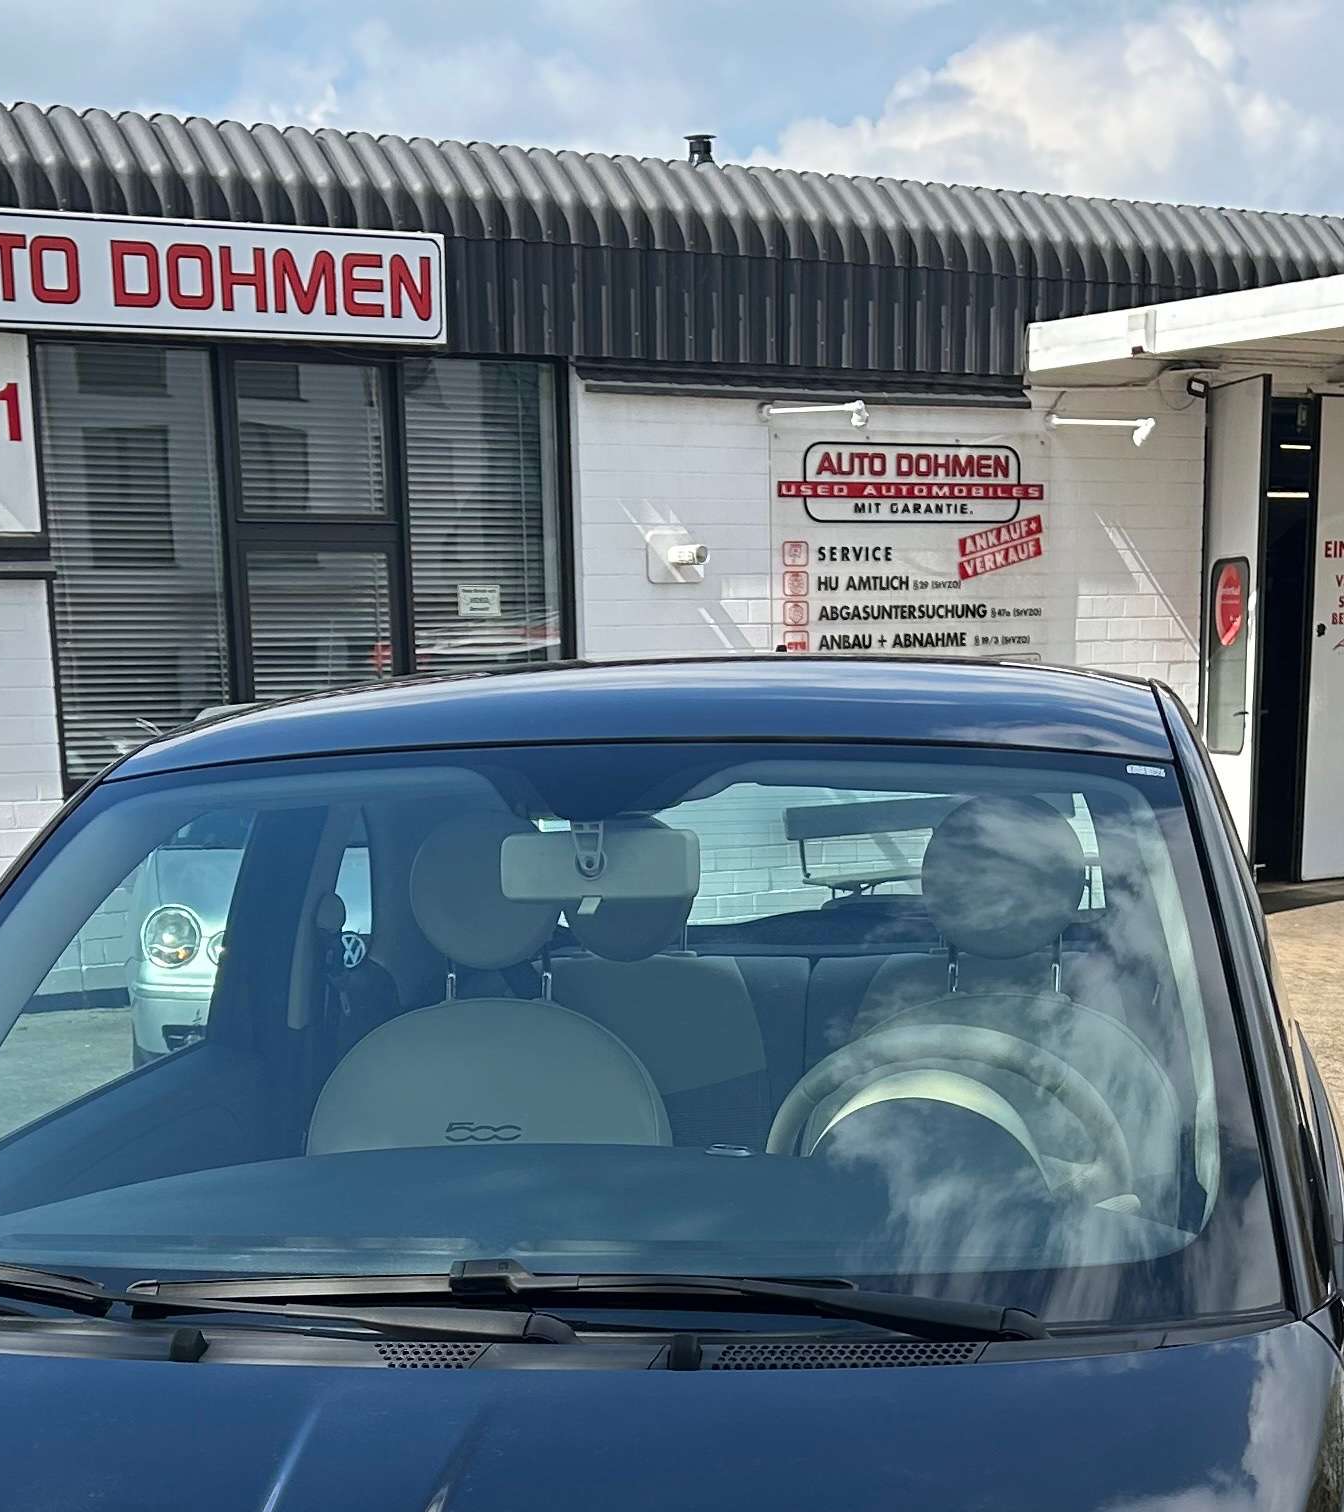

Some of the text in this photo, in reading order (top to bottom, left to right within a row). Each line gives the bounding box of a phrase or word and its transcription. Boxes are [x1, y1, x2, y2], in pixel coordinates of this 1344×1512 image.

[111, 239, 432, 322] DOHMEN
[816, 451, 1010, 478] AUTO DOHMEN
[780, 484, 1041, 498] USED AUTOMOBILES
[854, 502, 881, 514] MIT
[818, 546, 893, 562] SERVICE
[963, 543, 1038, 578] VERKAUF
[818, 576, 839, 591] HU
[846, 576, 909, 591] AMTLICH
[818, 604, 987, 621] ABGASUNTERSUCHUNG
[818, 634, 872, 650] ANBAU
[892, 632, 967, 648] ABNAHME
